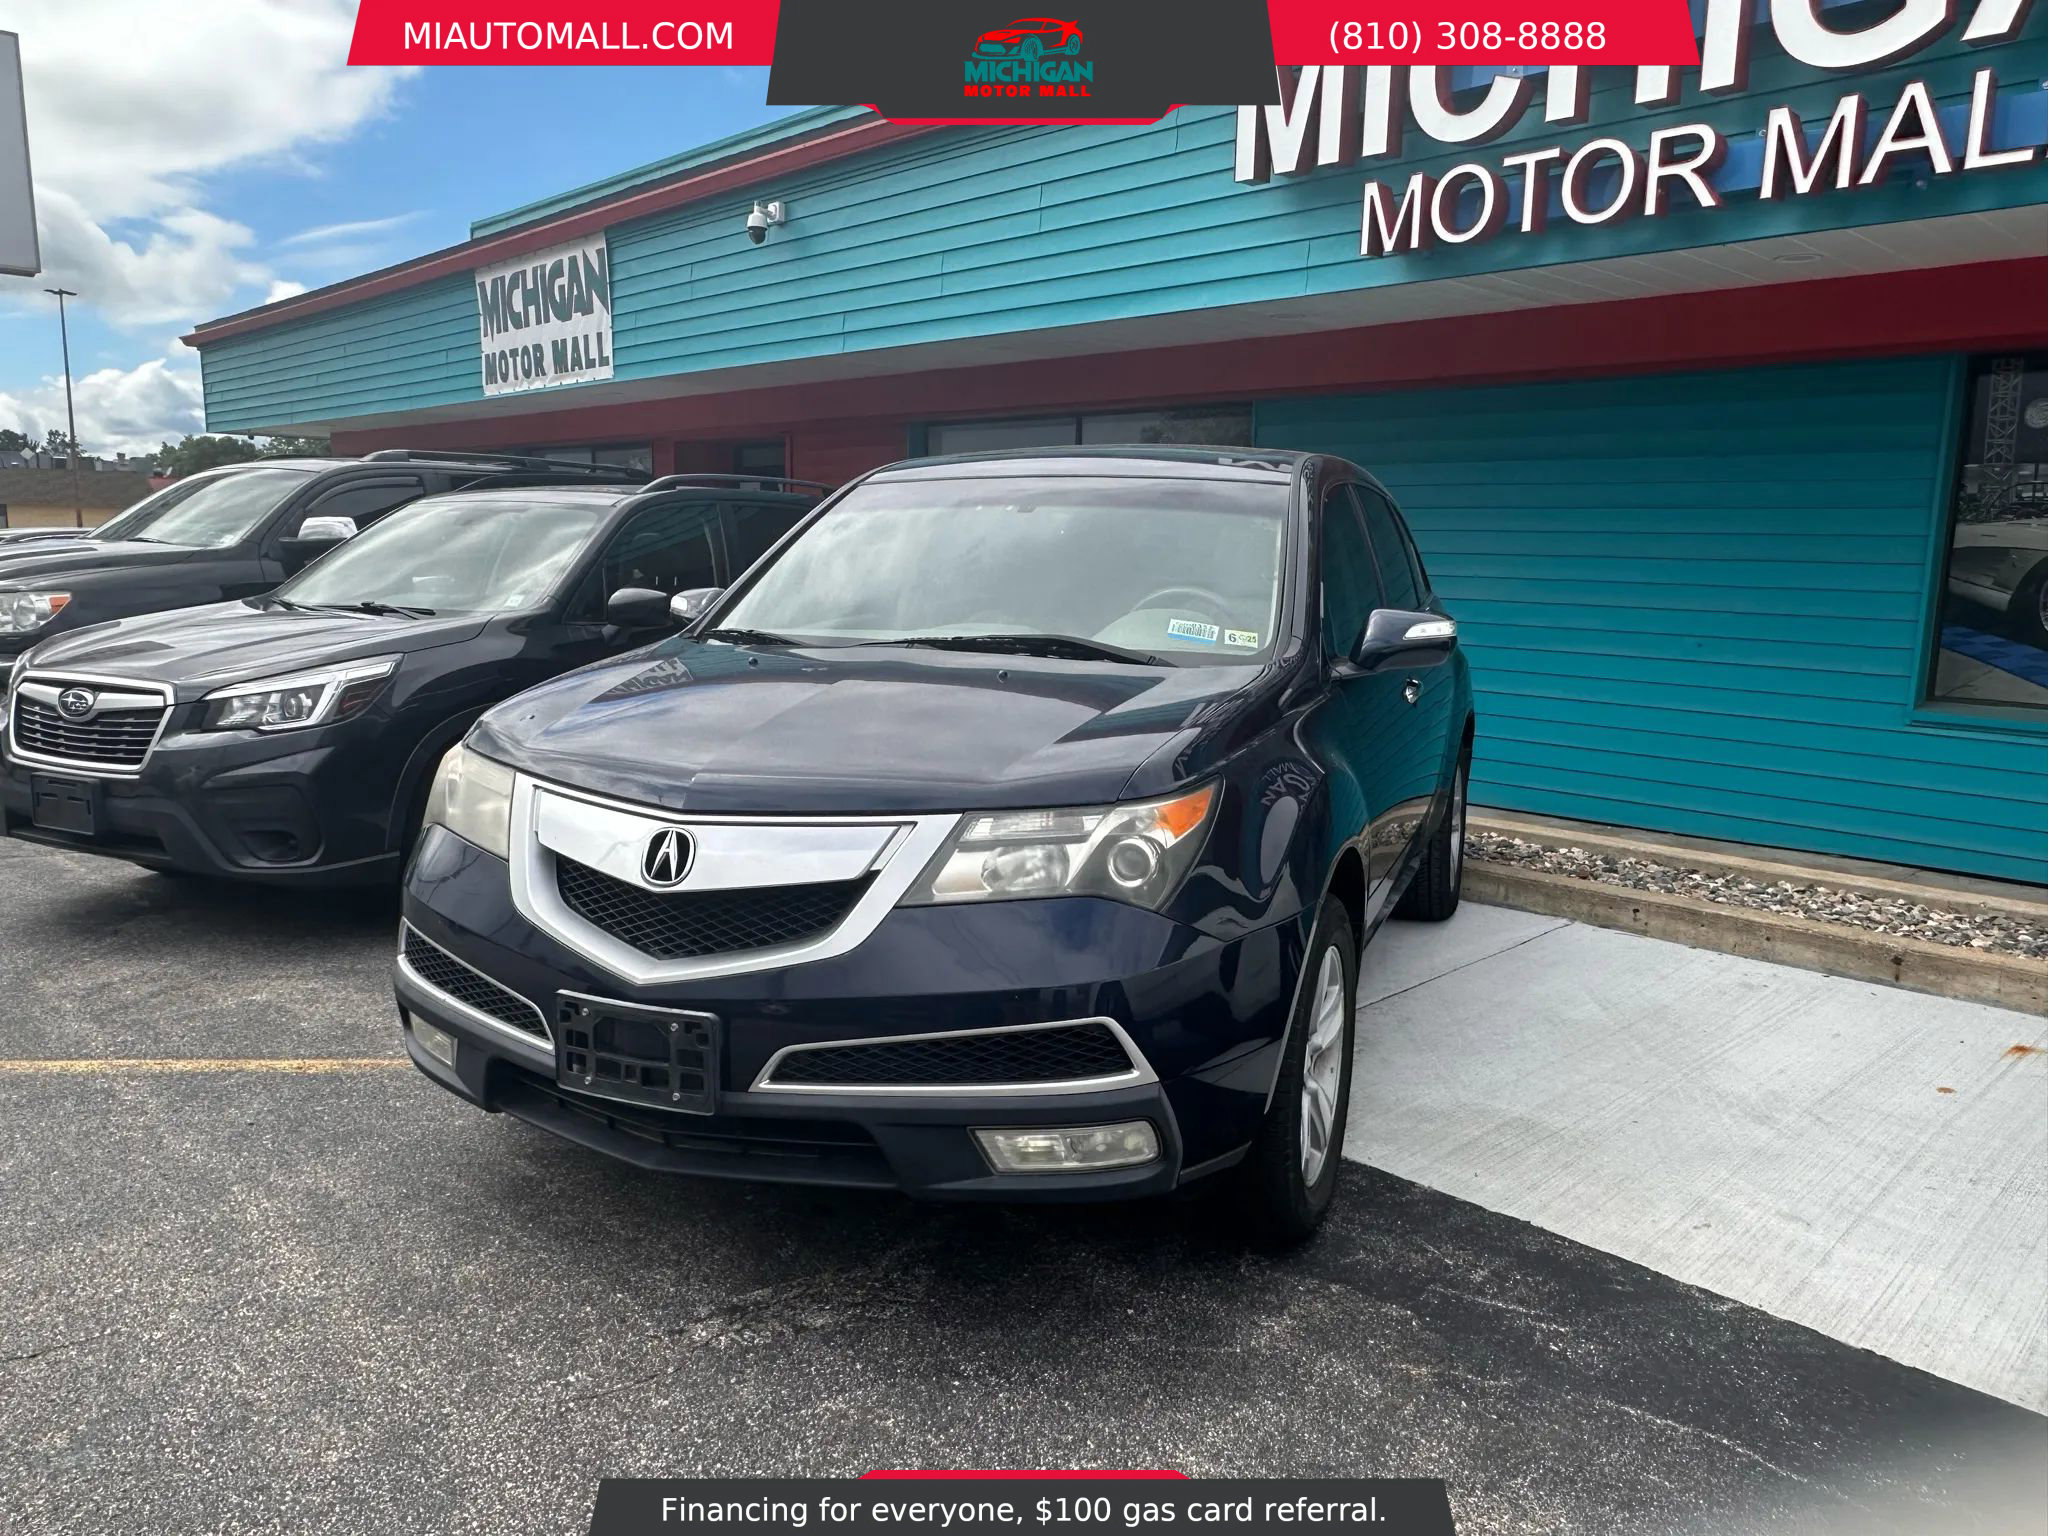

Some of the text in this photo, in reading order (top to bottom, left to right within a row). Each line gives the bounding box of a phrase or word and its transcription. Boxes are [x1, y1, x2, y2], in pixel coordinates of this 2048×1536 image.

[1360, 124, 1720, 256] MOTOR
[1760, 68, 2048, 200] MAL
[478, 247, 610, 342] MICHIGAN
[485, 332, 610, 385] MOTOR MALL
